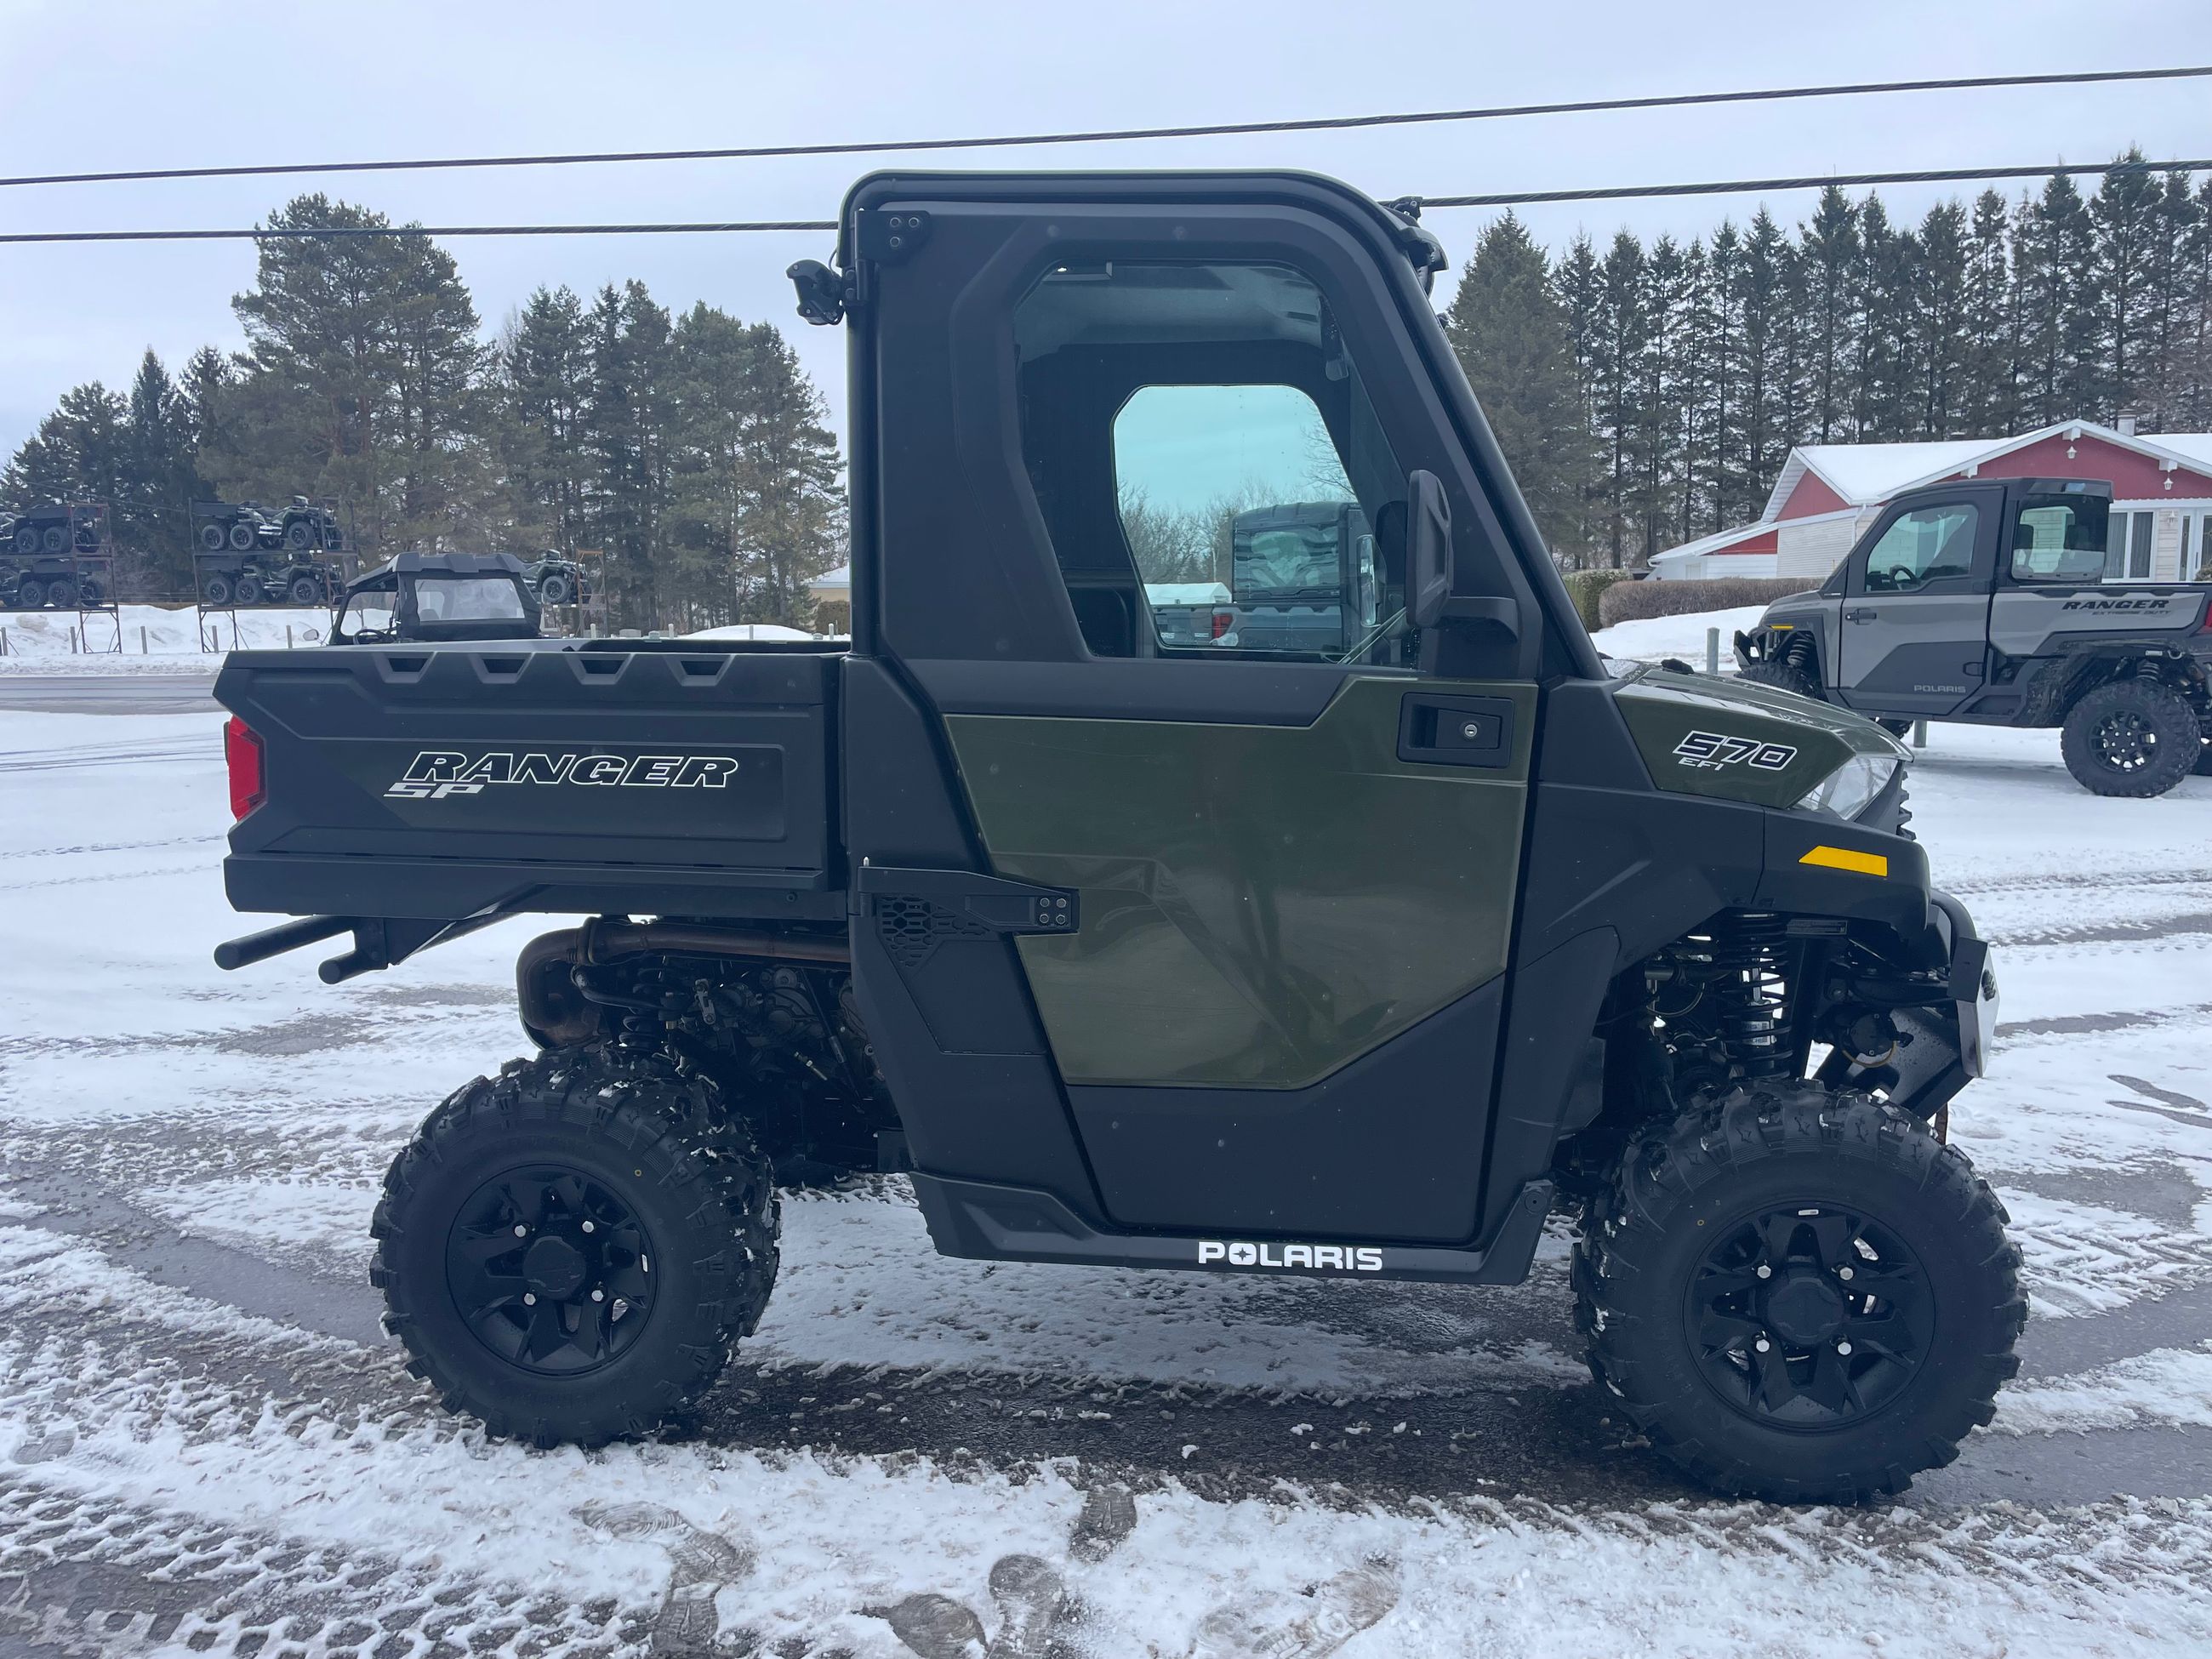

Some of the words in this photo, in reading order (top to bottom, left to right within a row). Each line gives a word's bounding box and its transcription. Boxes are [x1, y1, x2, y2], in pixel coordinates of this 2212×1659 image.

[2062, 600, 2169, 610] RANGER
[1913, 685, 1966, 693] POLARIS
[1672, 730, 1798, 771] 570
[402, 751, 738, 788] RANGER
[1679, 756, 1724, 771] EFI
[383, 782, 486, 799] SP
[1198, 1241, 1382, 1271] POLARIS
